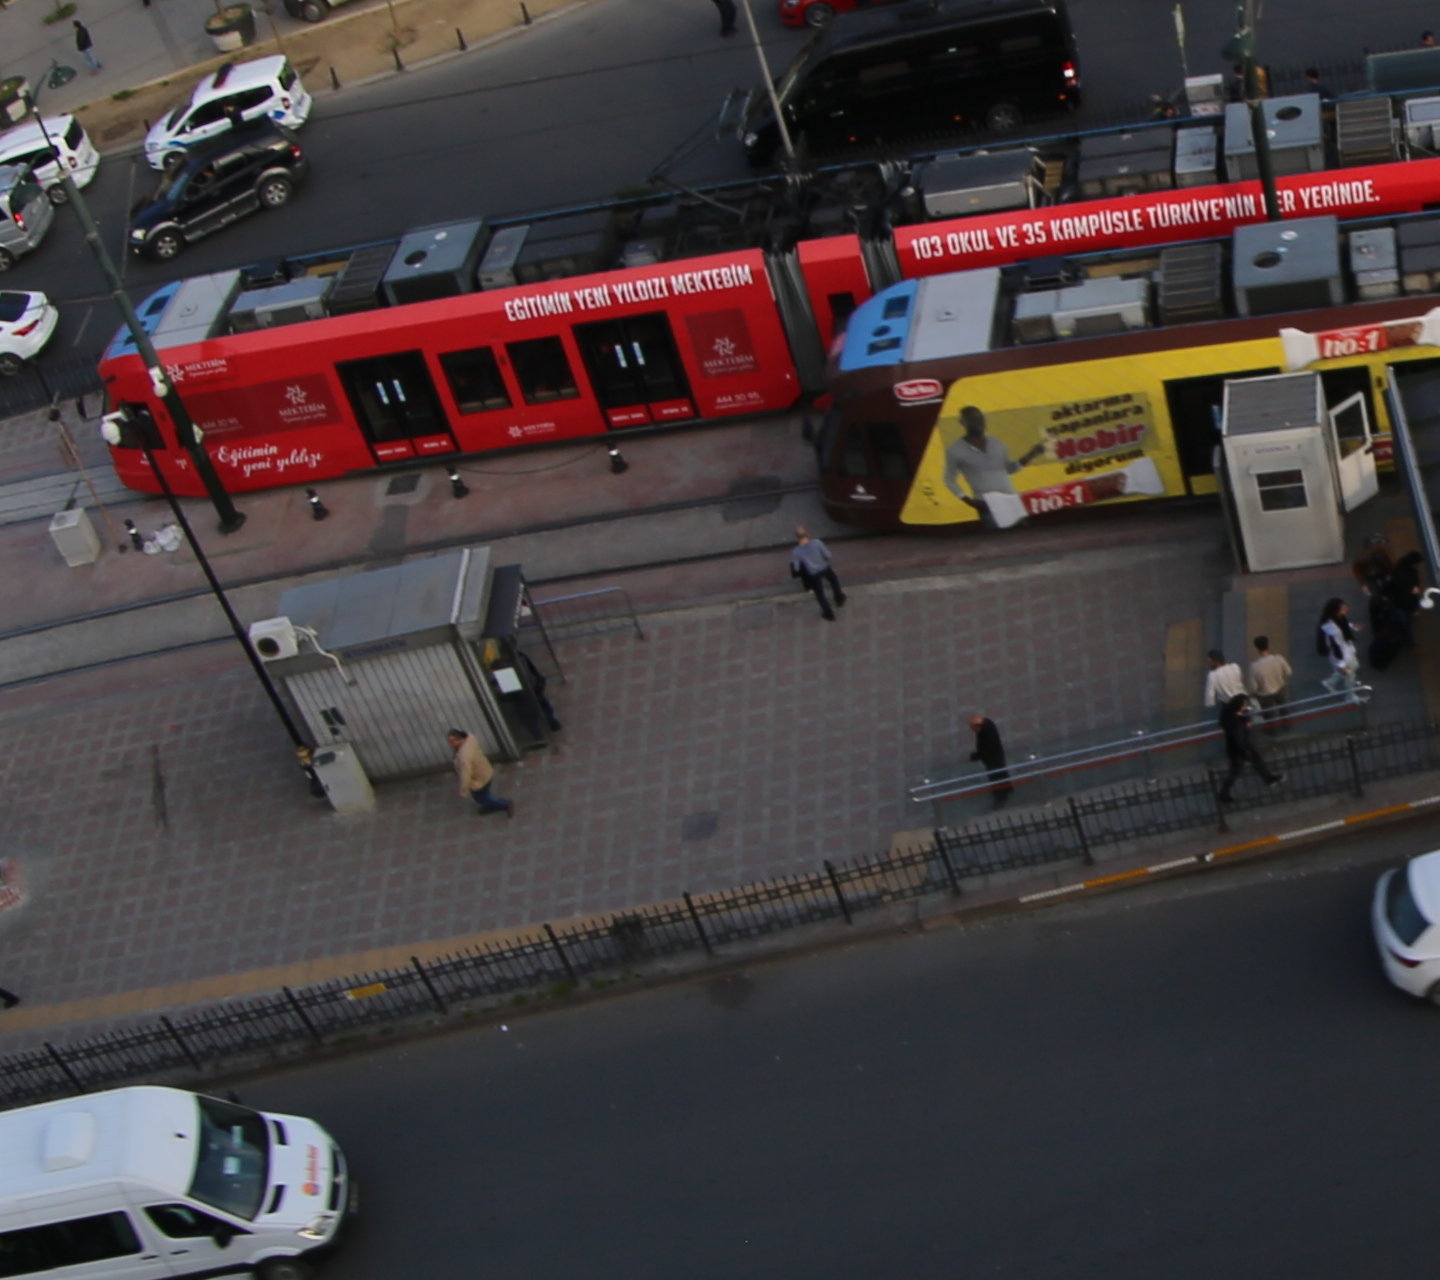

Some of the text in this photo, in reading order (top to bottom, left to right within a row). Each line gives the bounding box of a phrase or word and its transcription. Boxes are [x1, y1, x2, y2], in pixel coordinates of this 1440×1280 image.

[911, 235, 945, 261] 103
[947, 230, 993, 257] OKUL
[996, 225, 1021, 249] VE
[1025, 221, 1048, 245] 35
[1050, 208, 1144, 242] KAMPÜSLE
[1146, 192, 1256, 229] TÜRKİYE'NİN
[1299, 179, 1382, 211] YERİNDE.
[504, 263, 755, 323] EĞİTİMİN YENİ YILDIZI MEKTEBİM
[216, 442, 279, 469] Eğitimin
[1054, 423, 1147, 461] Nobir
[243, 447, 324, 478] yeni yıldızı
